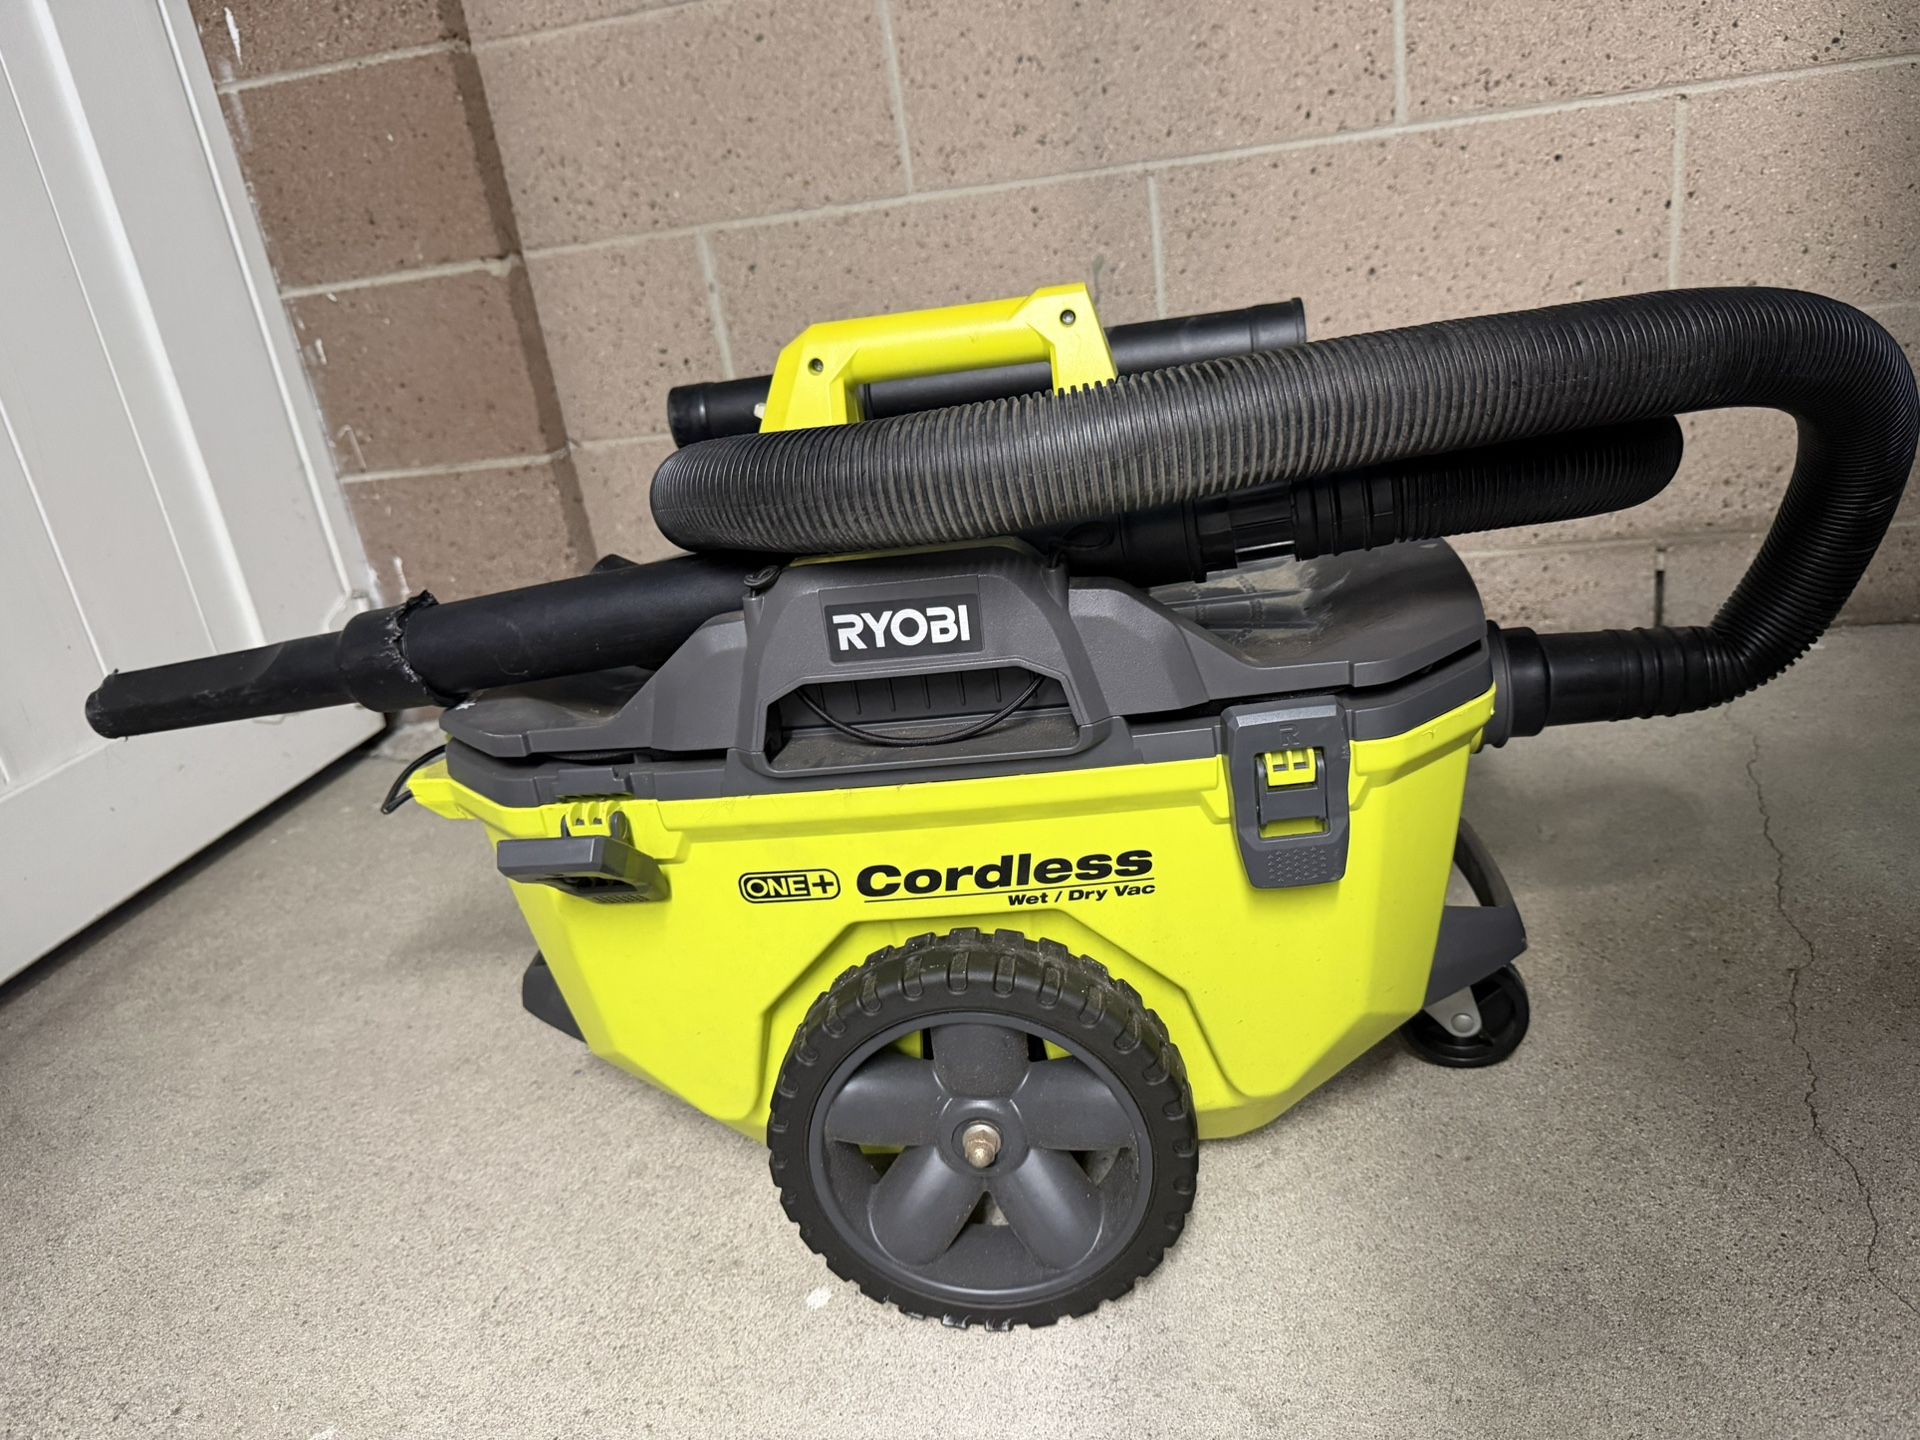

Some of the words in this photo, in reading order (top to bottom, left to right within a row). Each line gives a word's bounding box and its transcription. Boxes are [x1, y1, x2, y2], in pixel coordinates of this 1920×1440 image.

[832, 604, 971, 651] RYOBI
[745, 873, 835, 898] ONE+
[856, 849, 1154, 898] Cordless
[1008, 892, 1048, 906] Wet
[1054, 890, 1063, 903] /
[1068, 888, 1108, 901] Dry
[1114, 884, 1156, 897] Vac
